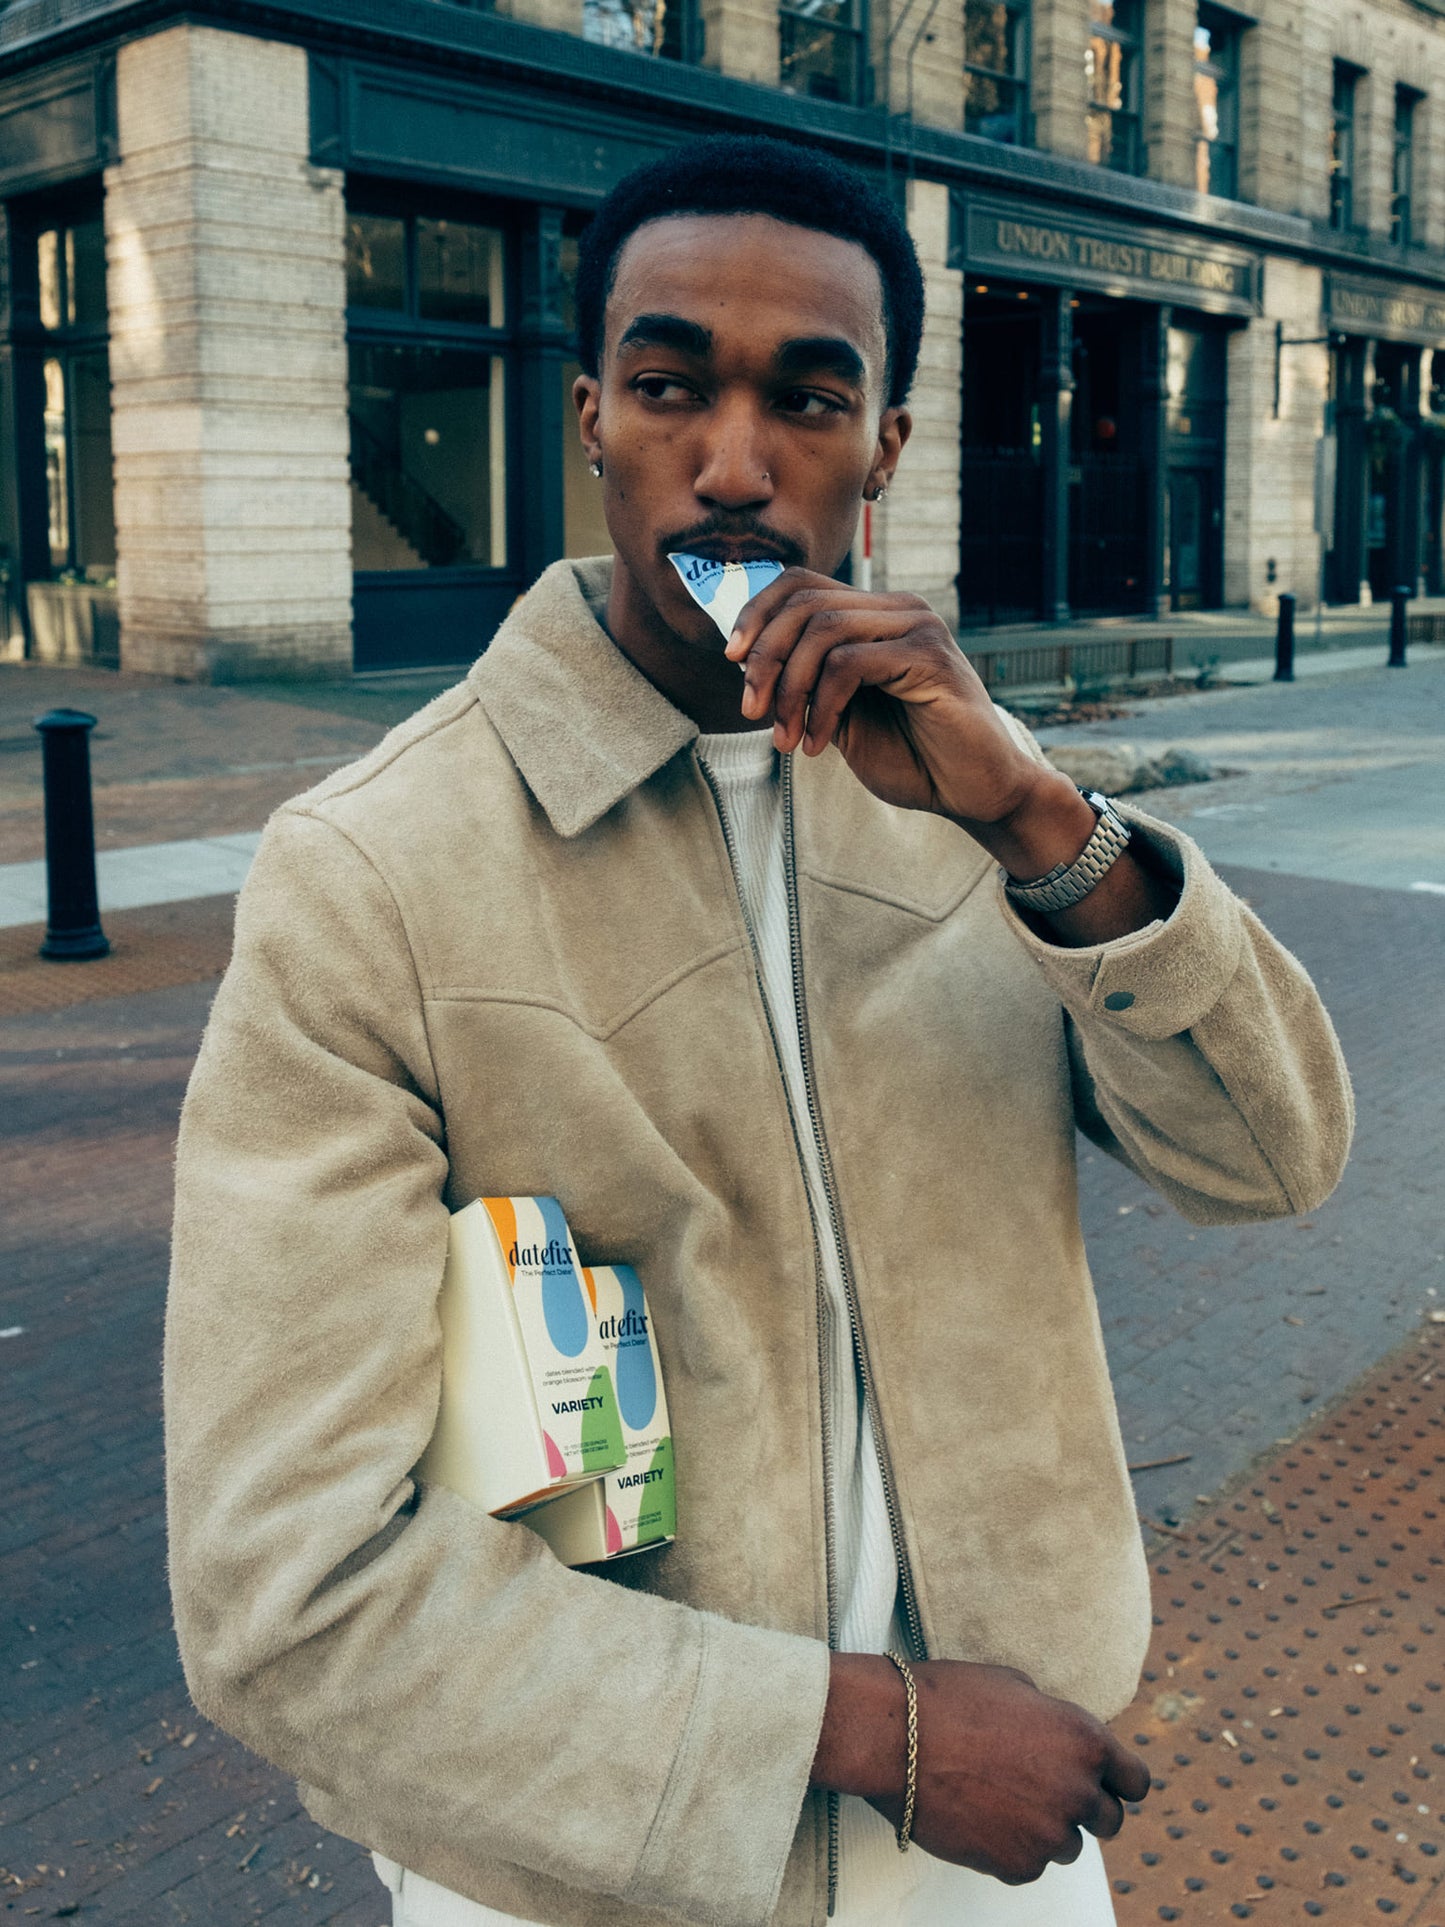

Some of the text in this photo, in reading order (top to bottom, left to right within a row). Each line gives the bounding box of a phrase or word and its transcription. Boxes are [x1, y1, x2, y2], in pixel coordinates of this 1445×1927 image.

[997, 220, 1235, 293] UNION TRUST BUILDING
[509, 1239, 574, 1266] datefix
[594, 1309, 648, 1339] atefix
[552, 1396, 604, 1415] VARIETY
[617, 1468, 664, 1490] VARIETY
